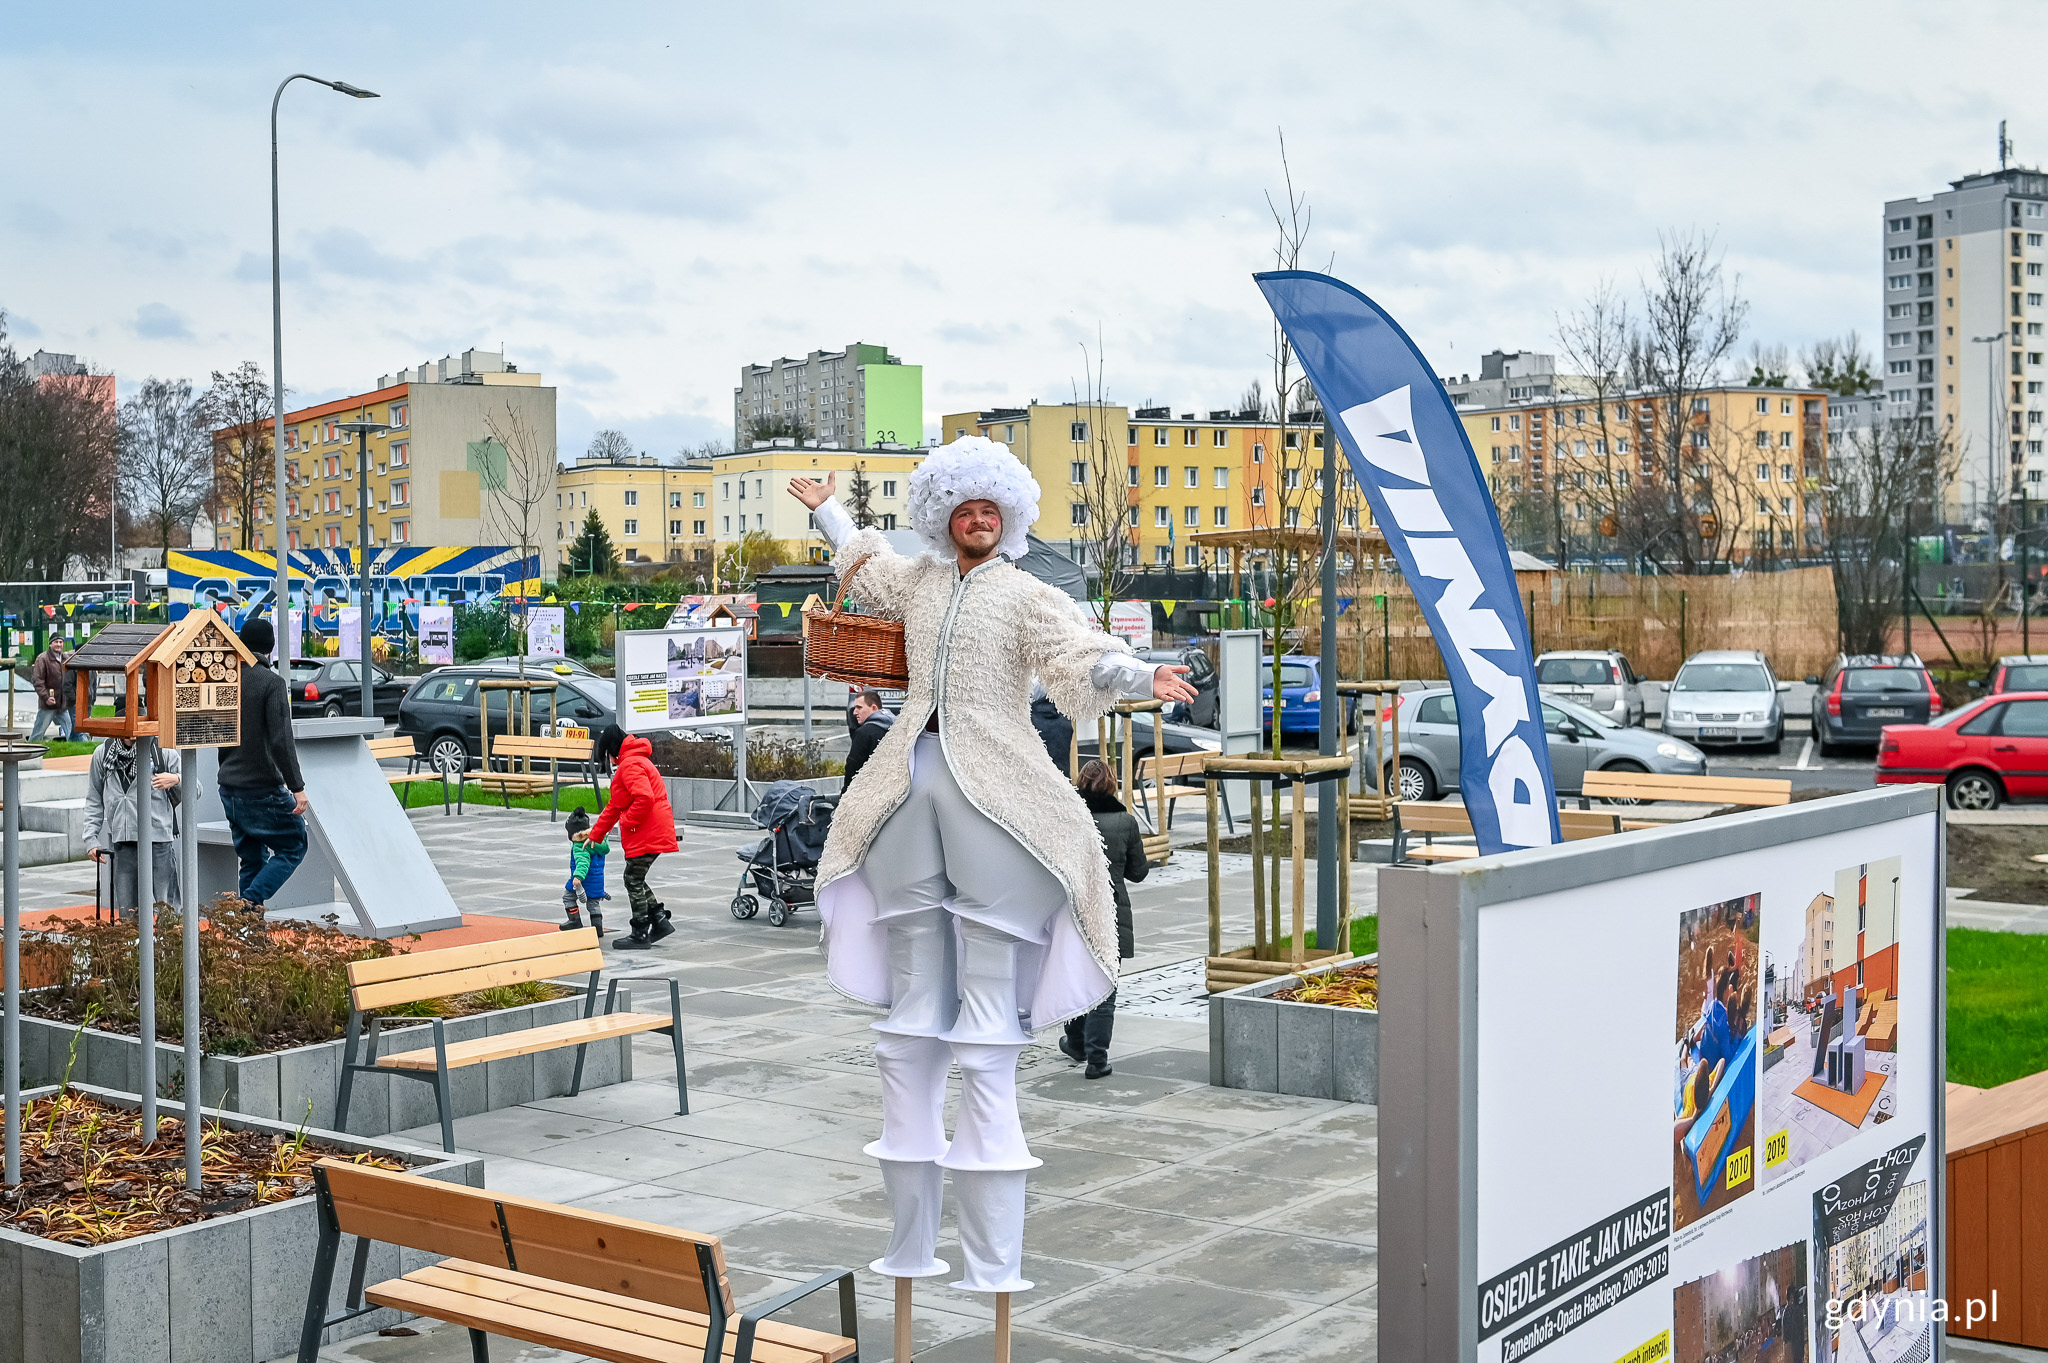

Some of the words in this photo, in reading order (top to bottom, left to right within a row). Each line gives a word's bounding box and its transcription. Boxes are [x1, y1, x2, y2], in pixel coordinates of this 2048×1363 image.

[876, 430, 896, 444] 33
[1338, 384, 1551, 847] DYNIA
[1766, 1135, 1786, 1163] 2019
[1728, 1153, 1749, 1182] 2010
[1481, 1259, 1547, 1329] OSIEDLE
[1550, 1236, 1592, 1291] TAKIE
[1593, 1219, 1622, 1267] JAK
[1622, 1196, 1668, 1249] NASZE
[1503, 1301, 1582, 1363] Zamenhofa-Opata
[1583, 1277, 1622, 1318] Hackiego
[1622, 1250, 1668, 1292] 2009-2019
[1642, 1333, 1668, 1362] intencji,
